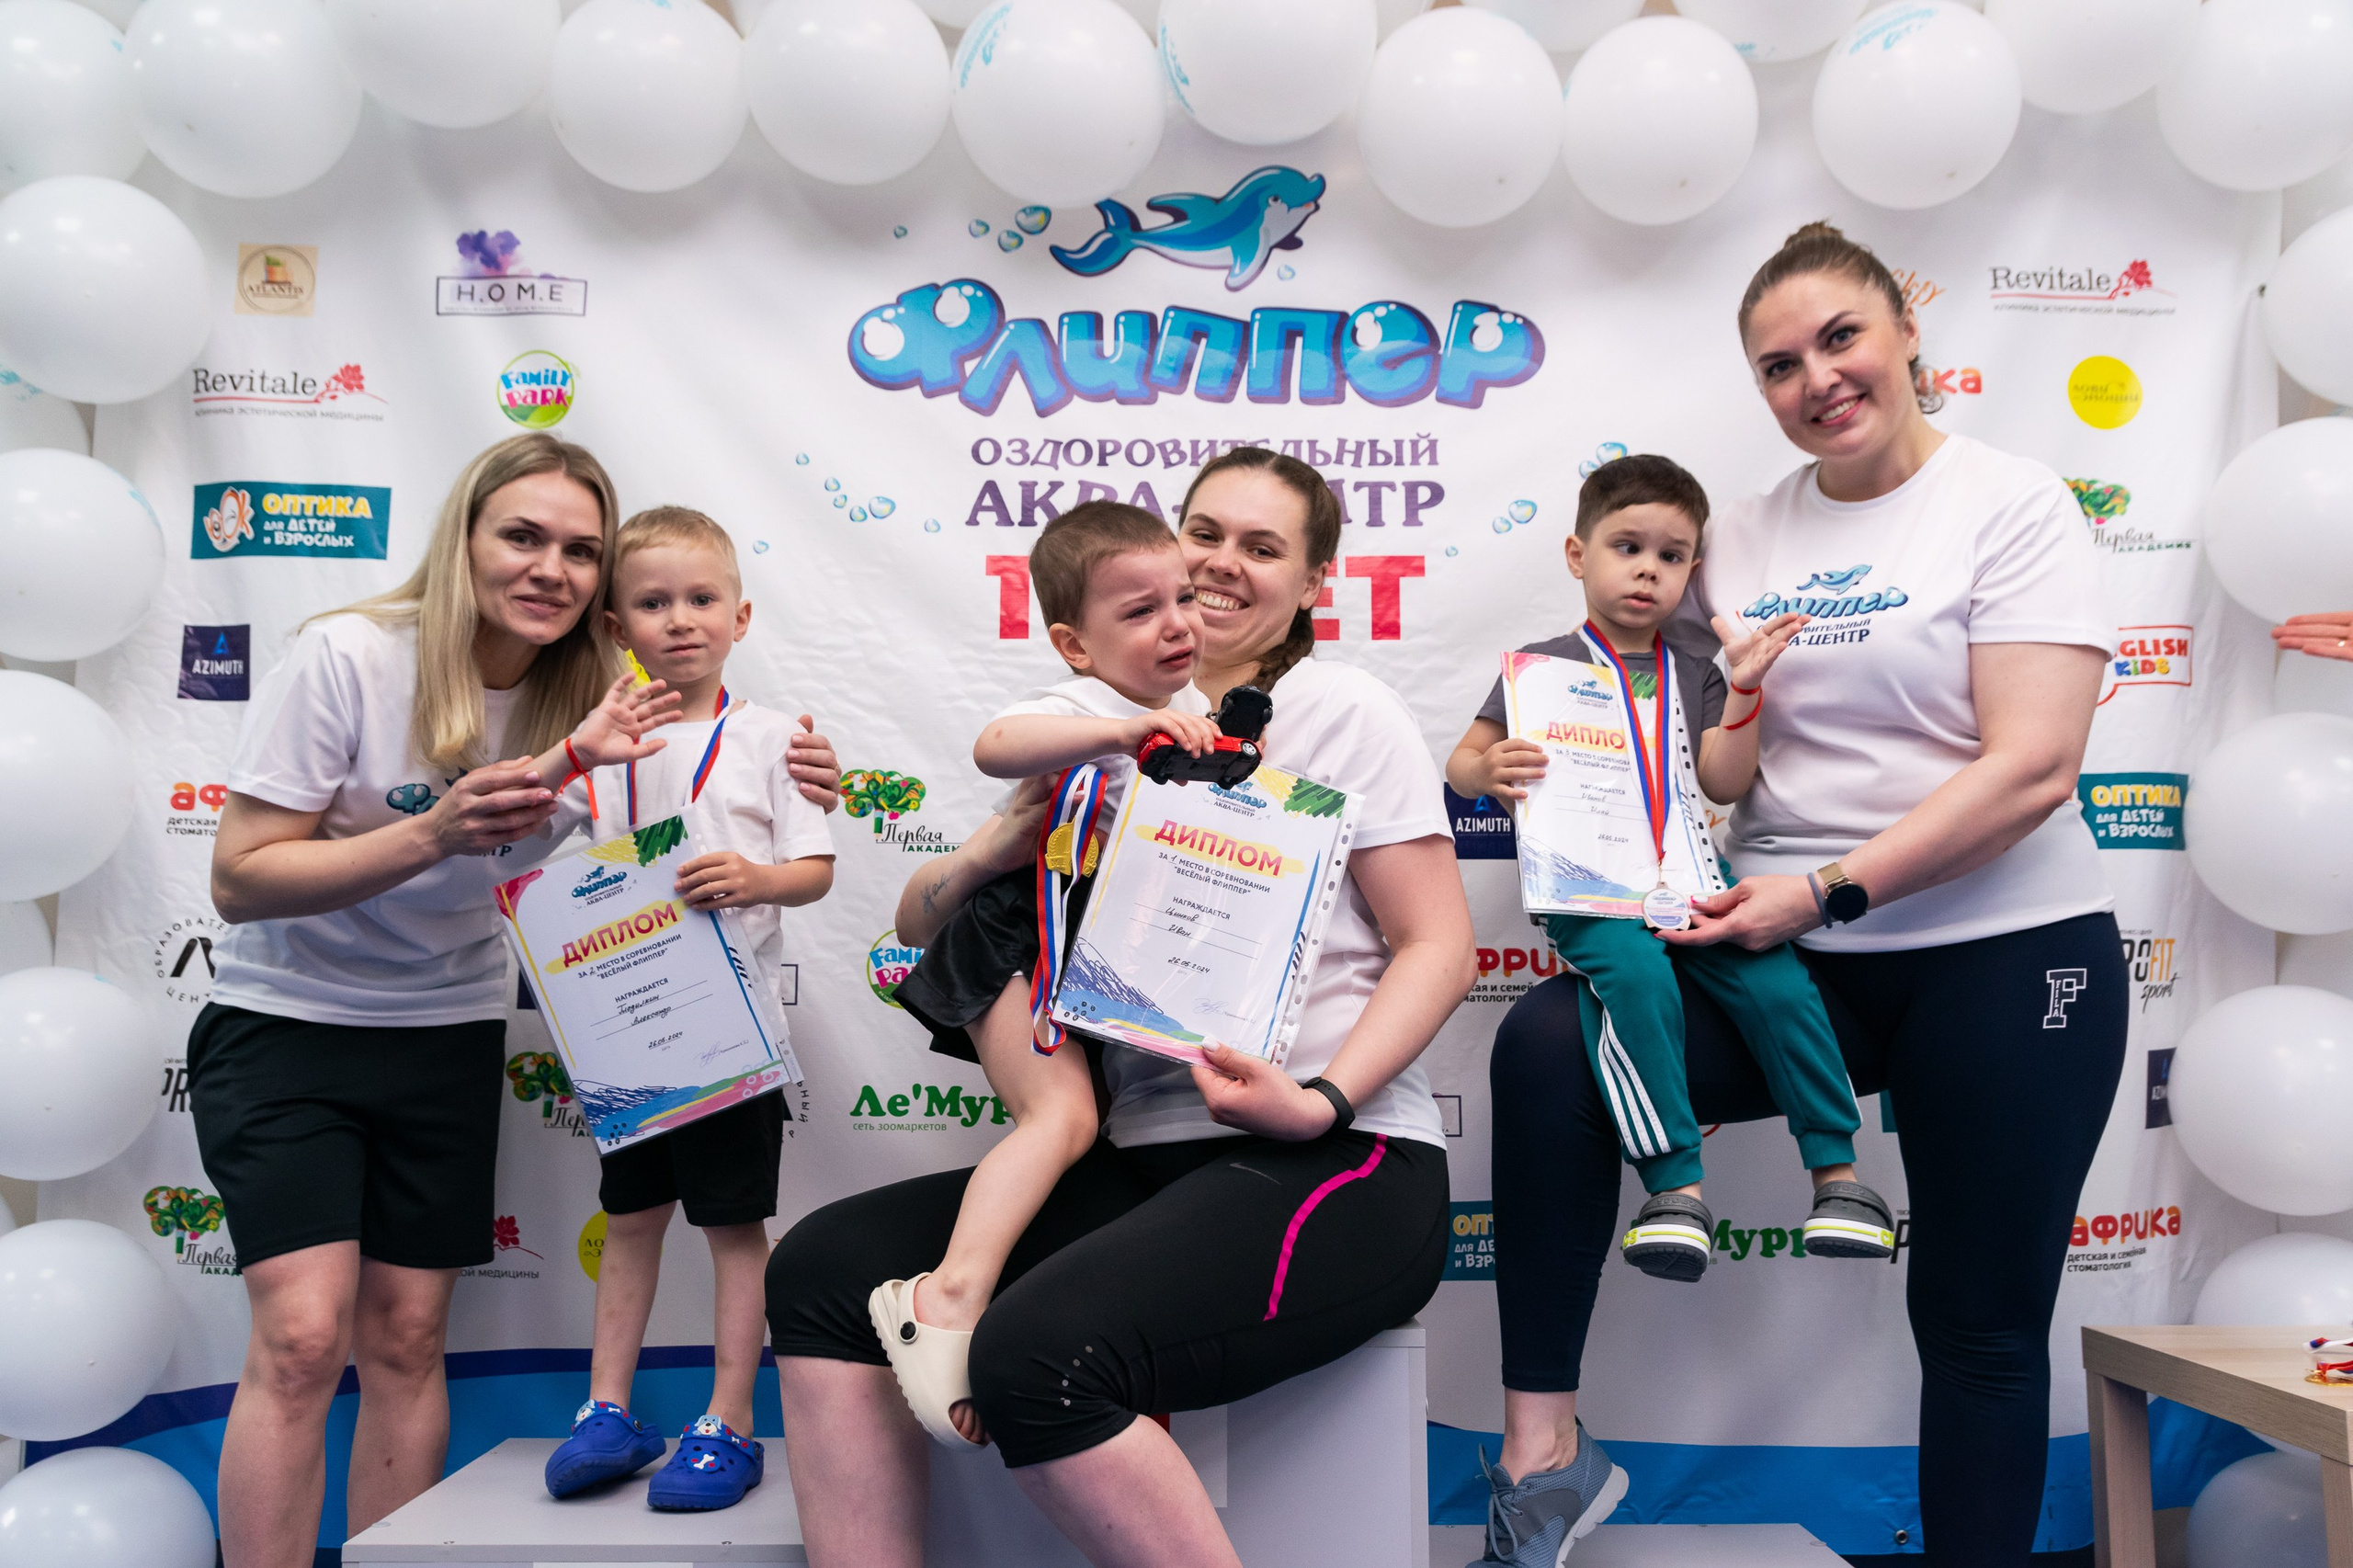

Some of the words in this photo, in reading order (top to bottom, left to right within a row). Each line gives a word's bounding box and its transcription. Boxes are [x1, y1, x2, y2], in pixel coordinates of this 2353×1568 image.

[1989, 266, 2110, 292] Revitale
[194, 369, 317, 397] Revitale
[971, 432, 1439, 471] ОЗДОРОВИЛЬНЫЙ
[262, 493, 373, 519] ОПТИКА
[274, 530, 355, 548] ВЗРОСЛЫХ
[1789, 629, 1870, 646] А-ЦЕНТР
[2119, 639, 2188, 657] GLISH
[192, 659, 244, 675] AZIMUTH
[1546, 722, 1625, 749] ДИПЛО
[1597, 756, 1630, 766] СОРЕВНОВА
[2090, 784, 2181, 807] ОПТИКА
[166, 827, 217, 836] стомато
[1455, 817, 1510, 833] AZIMUTH
[883, 824, 943, 852] Первая
[907, 845, 960, 853] АКАДЕМ
[1154, 819, 1282, 877] ДИПЛОМ
[1158, 852, 1168, 860] ЗА
[1178, 858, 1204, 871] МЕСТО
[1210, 869, 1270, 893] СОРЕВНОВАНИИ
[586, 888, 624, 905] АКВА-ЦЕНТР
[1173, 896, 1231, 920] НАГРАЖДАЕТСЯ
[562, 903, 677, 968] ДИПЛОМ
[154, 917, 228, 978] ОБРАЗОВАТЕ
[589, 967, 597, 975] 2
[597, 959, 620, 971] МЕСТО
[626, 933, 682, 960] СОРЕВНОВАНИИ
[2120, 938, 2176, 983] OFIT
[166, 985, 211, 1004] ЦЕН
[615, 977, 668, 1003] НАГРАЖДАЕТСЯ
[1500, 982, 1535, 993] семей
[2052, 980, 2062, 1017] FILA
[2141, 971, 2181, 1015] sport
[849, 1083, 1012, 1128] Ле'Мур
[853, 1122, 874, 1131] сеть
[878, 1122, 947, 1133] зоомаркетов
[2067, 1252, 2109, 1263] детская
[2067, 1261, 2131, 1273] стоматология
[205, 1267, 240, 1277] АКАД
[478, 1269, 540, 1278] медицины
